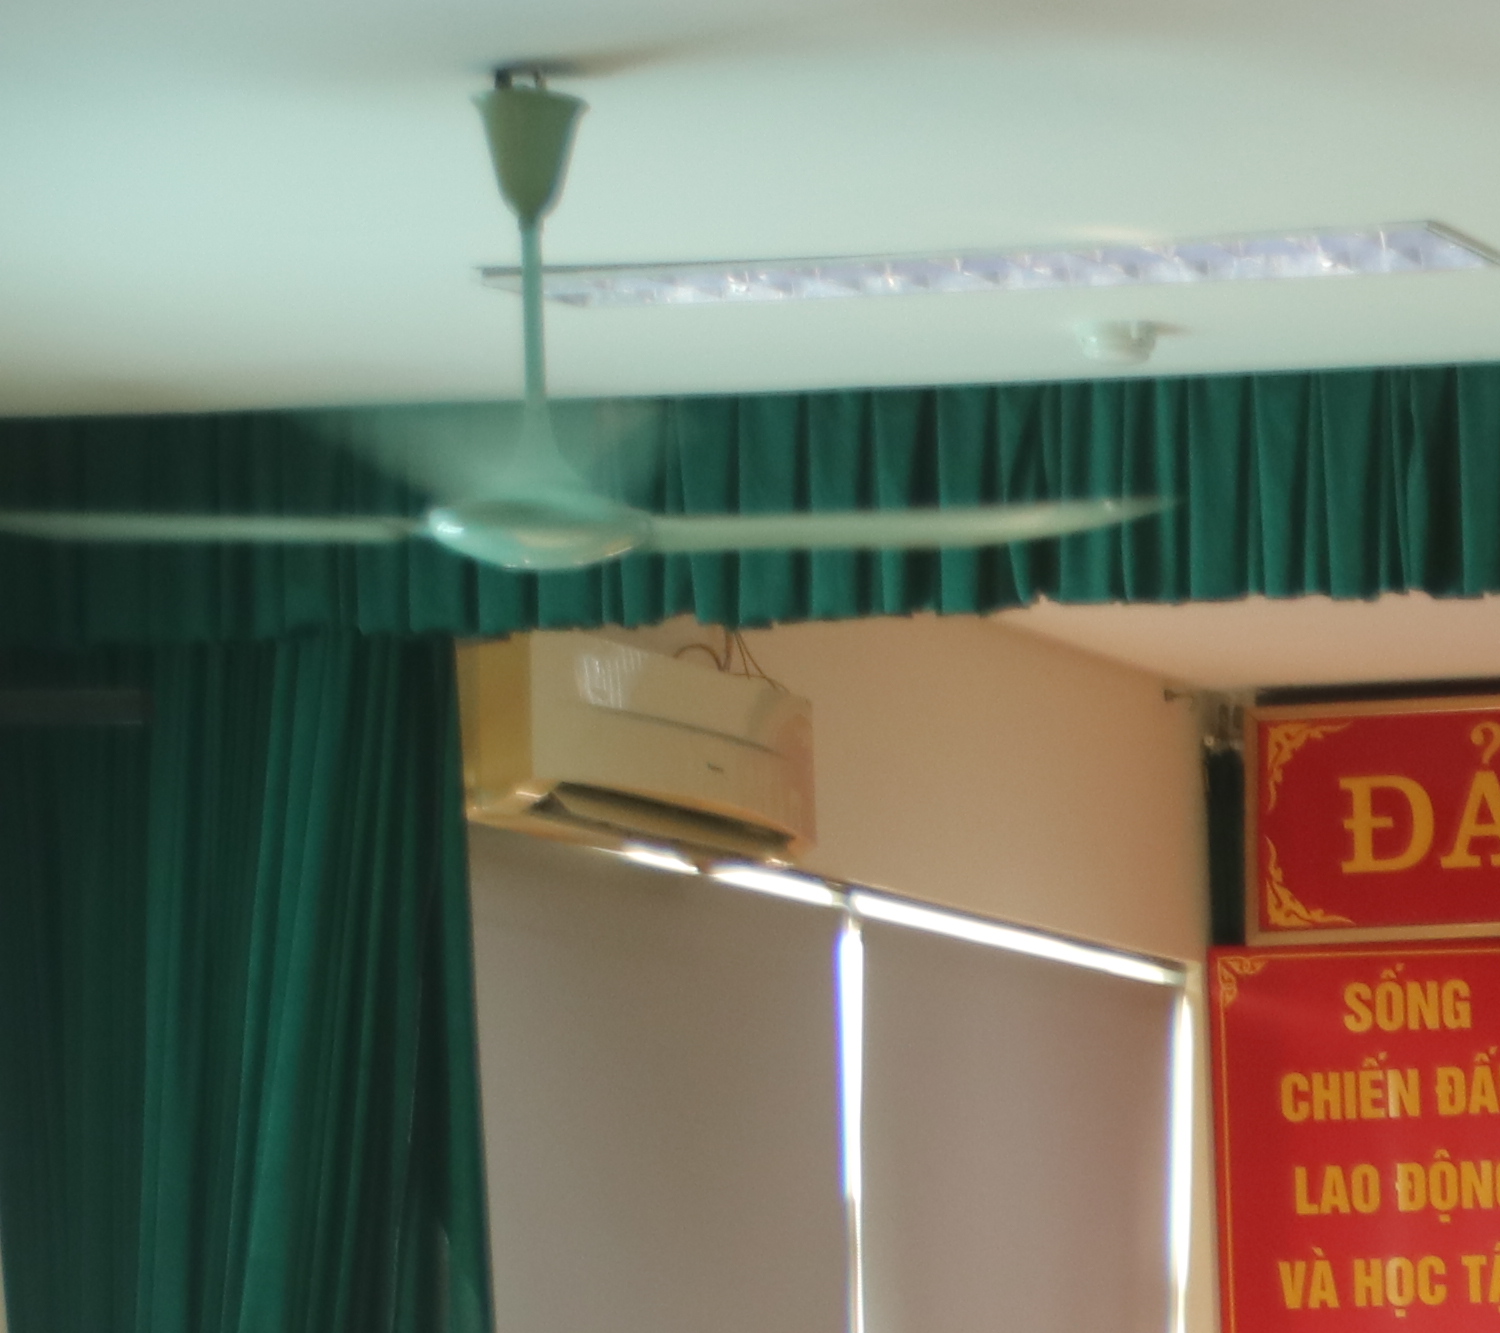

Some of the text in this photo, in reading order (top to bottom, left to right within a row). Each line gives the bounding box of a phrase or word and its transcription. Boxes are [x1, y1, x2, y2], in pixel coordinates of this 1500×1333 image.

[1343, 963, 1472, 1033] SỐNG
[1281, 1052, 1421, 1122] CHIẾN
[1295, 1164, 1381, 1215] LAO
[1279, 1248, 1340, 1309] VÀ
[1354, 1256, 1446, 1318] HỌC
